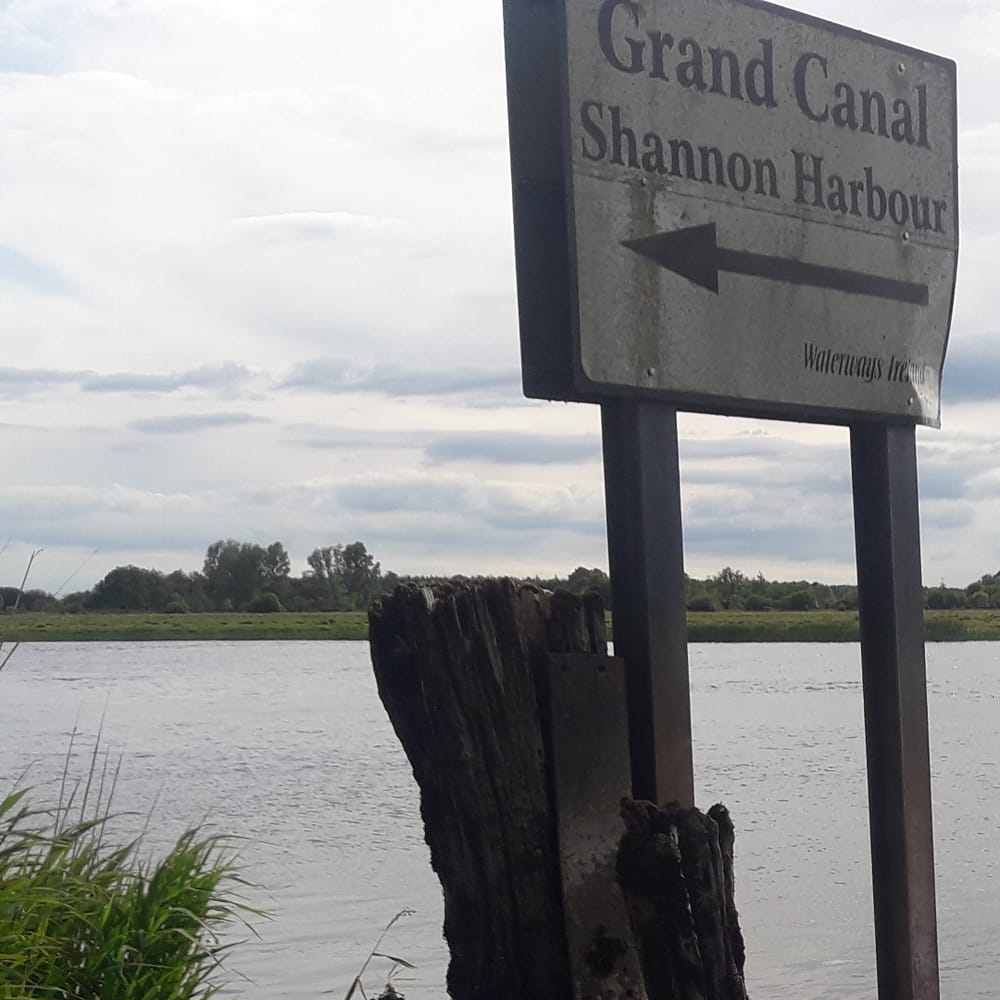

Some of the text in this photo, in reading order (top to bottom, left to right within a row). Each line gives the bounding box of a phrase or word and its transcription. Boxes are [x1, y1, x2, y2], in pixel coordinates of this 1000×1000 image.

[599, 0, 931, 150] Grand Canal
[580, 102, 947, 233] Shannon Harbour
[804, 343, 882, 382] Waterways
